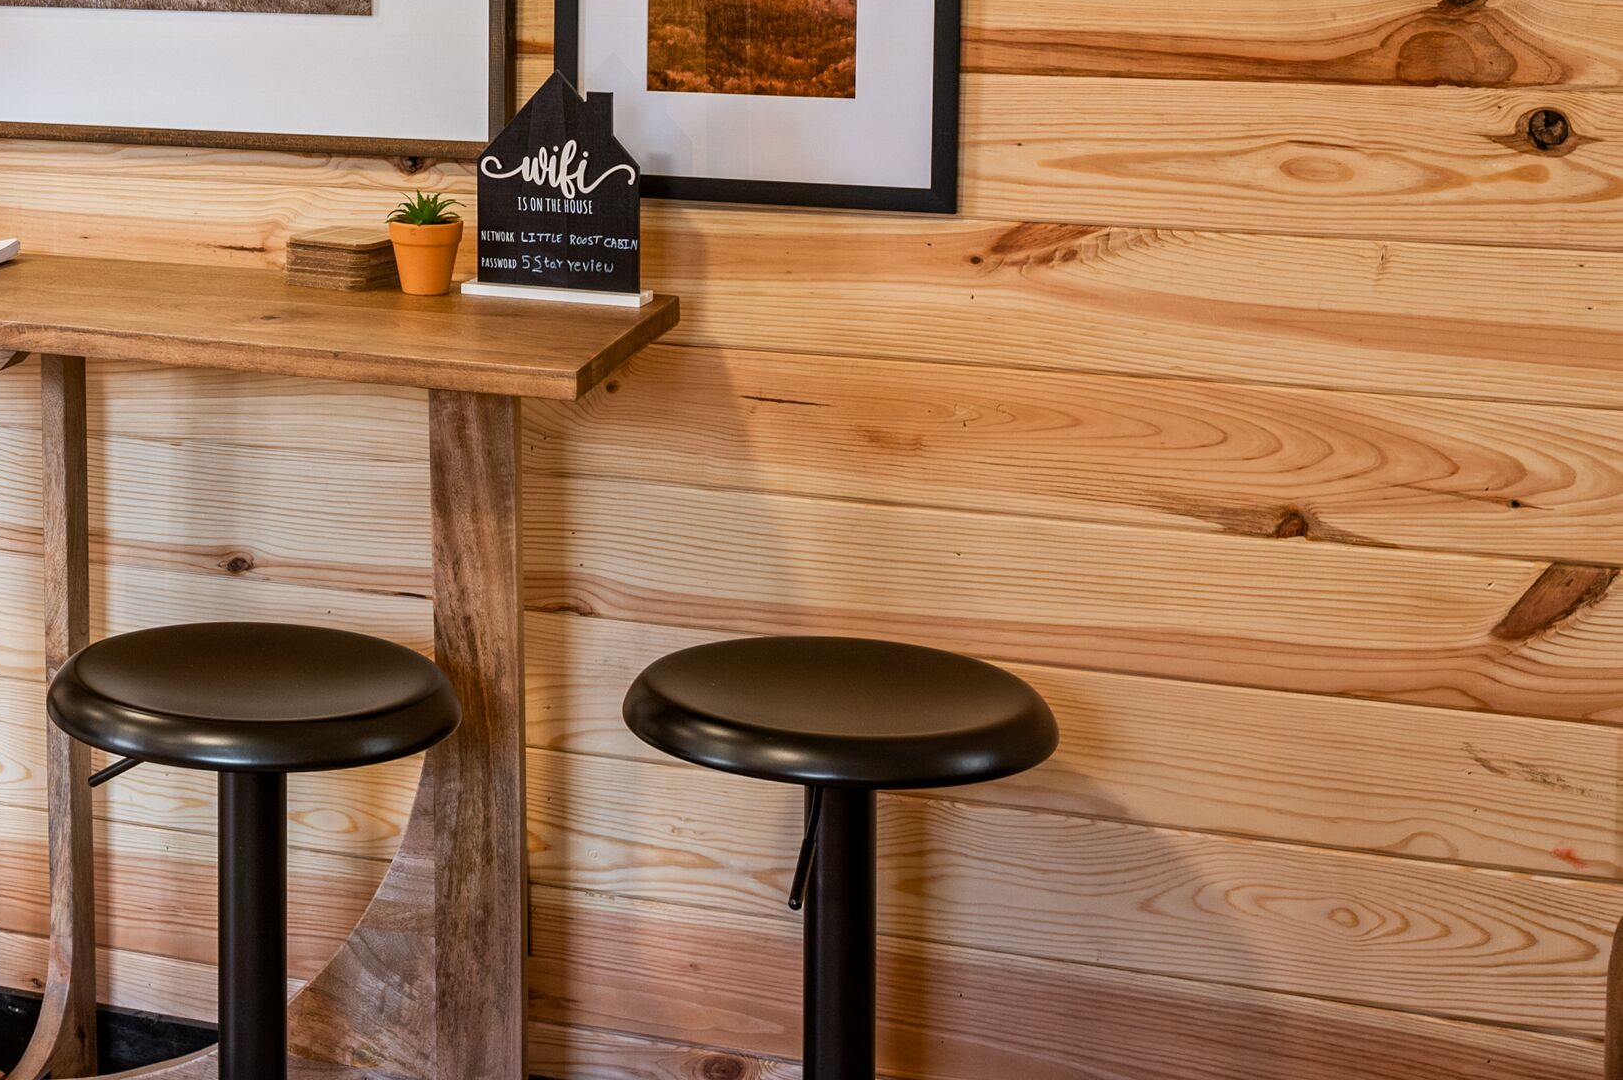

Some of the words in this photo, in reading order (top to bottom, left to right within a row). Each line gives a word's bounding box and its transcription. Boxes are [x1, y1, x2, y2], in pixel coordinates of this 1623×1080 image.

[480, 139, 636, 199] wifi
[518, 196, 528, 211] IS
[530, 197, 543, 212] ON
[545, 198, 562, 213] THE
[564, 199, 593, 215] HOUSE
[481, 230, 515, 243] NETWORK
[520, 232, 563, 244] LITTLE
[569, 234, 603, 246] ROOST
[603, 237, 638, 251] CABIN
[481, 257, 517, 270] PASSWORD
[567, 259, 614, 273] review
